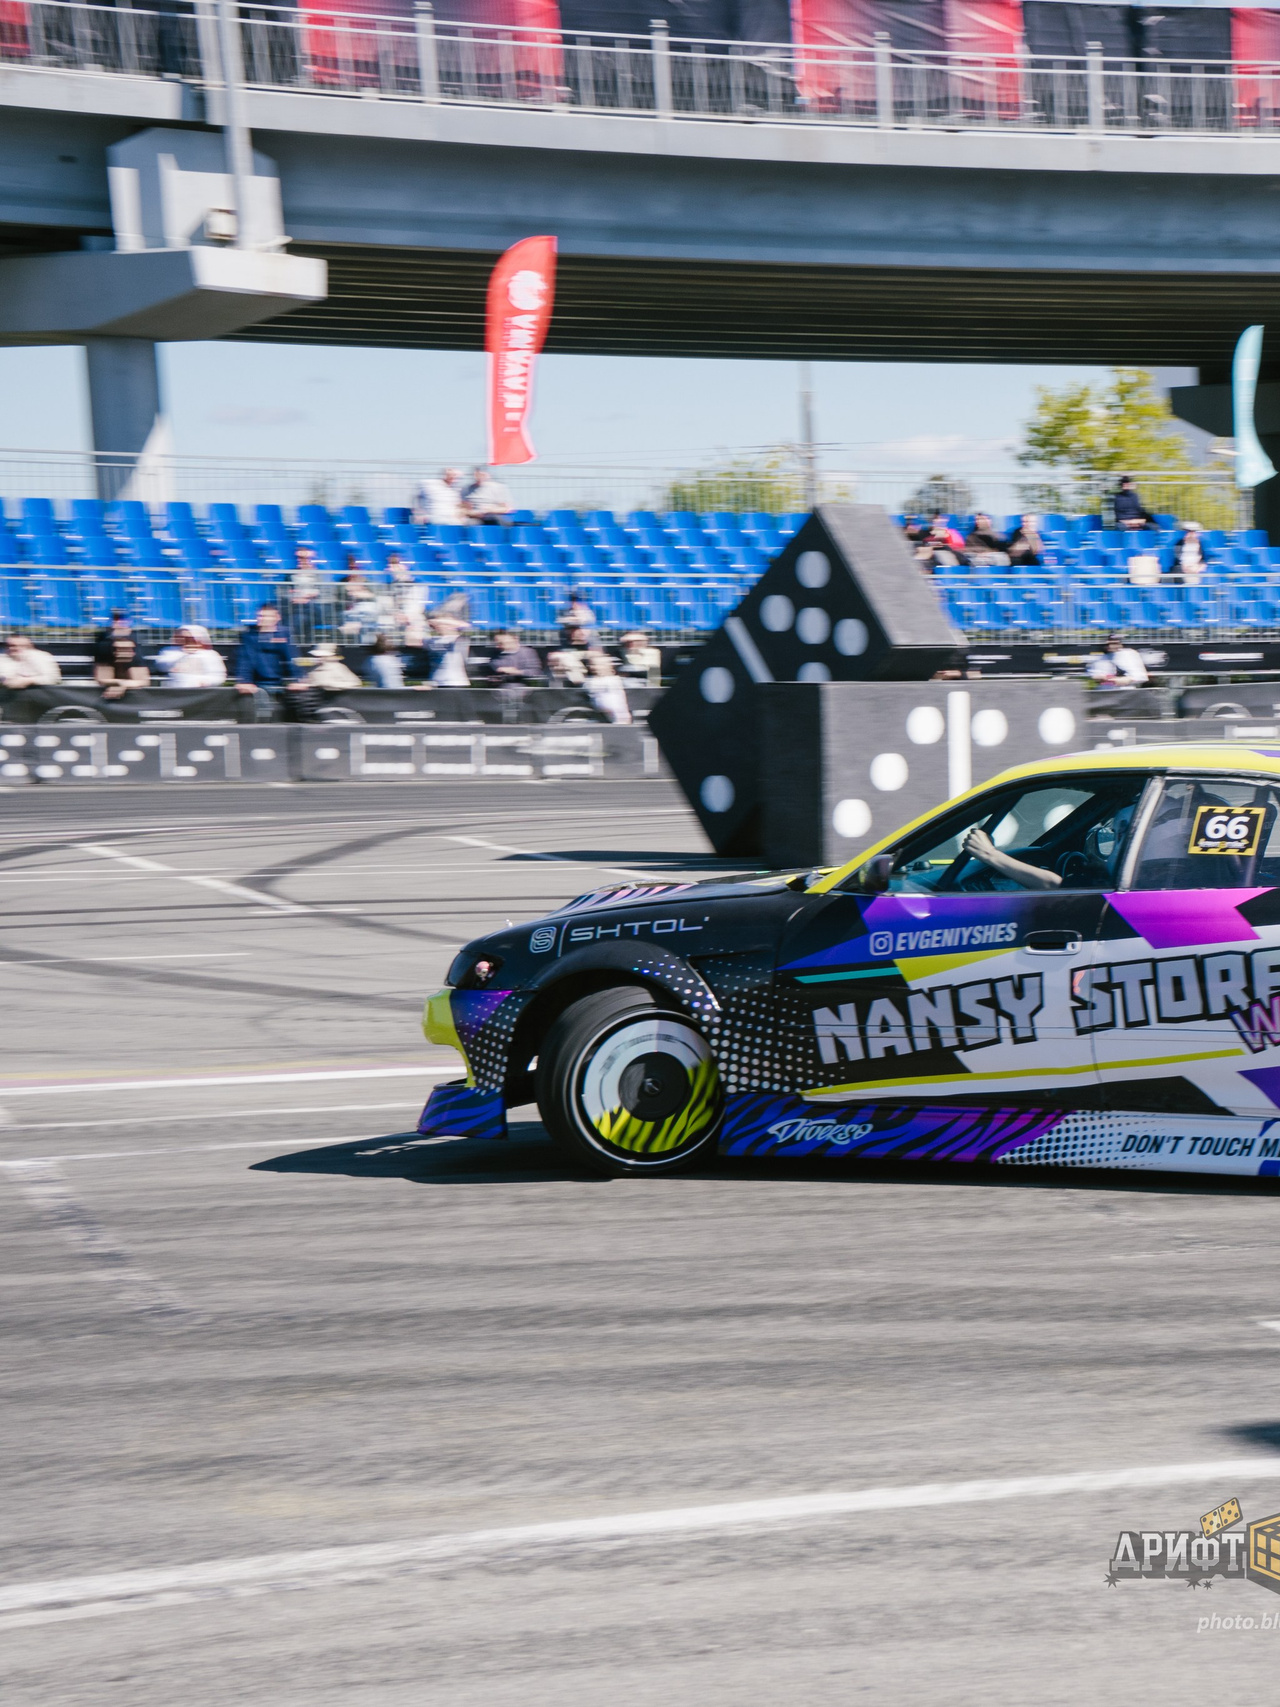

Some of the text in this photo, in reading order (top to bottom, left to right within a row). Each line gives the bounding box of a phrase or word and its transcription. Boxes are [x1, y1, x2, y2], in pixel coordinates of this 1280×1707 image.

[1205, 815, 1250, 840] 66
[895, 922, 1018, 951] EVGENIYSHES
[811, 971, 1044, 1065] NANSY
[1121, 1134, 1185, 1154] DON'T
[1188, 1136, 1257, 1157] TOUCH
